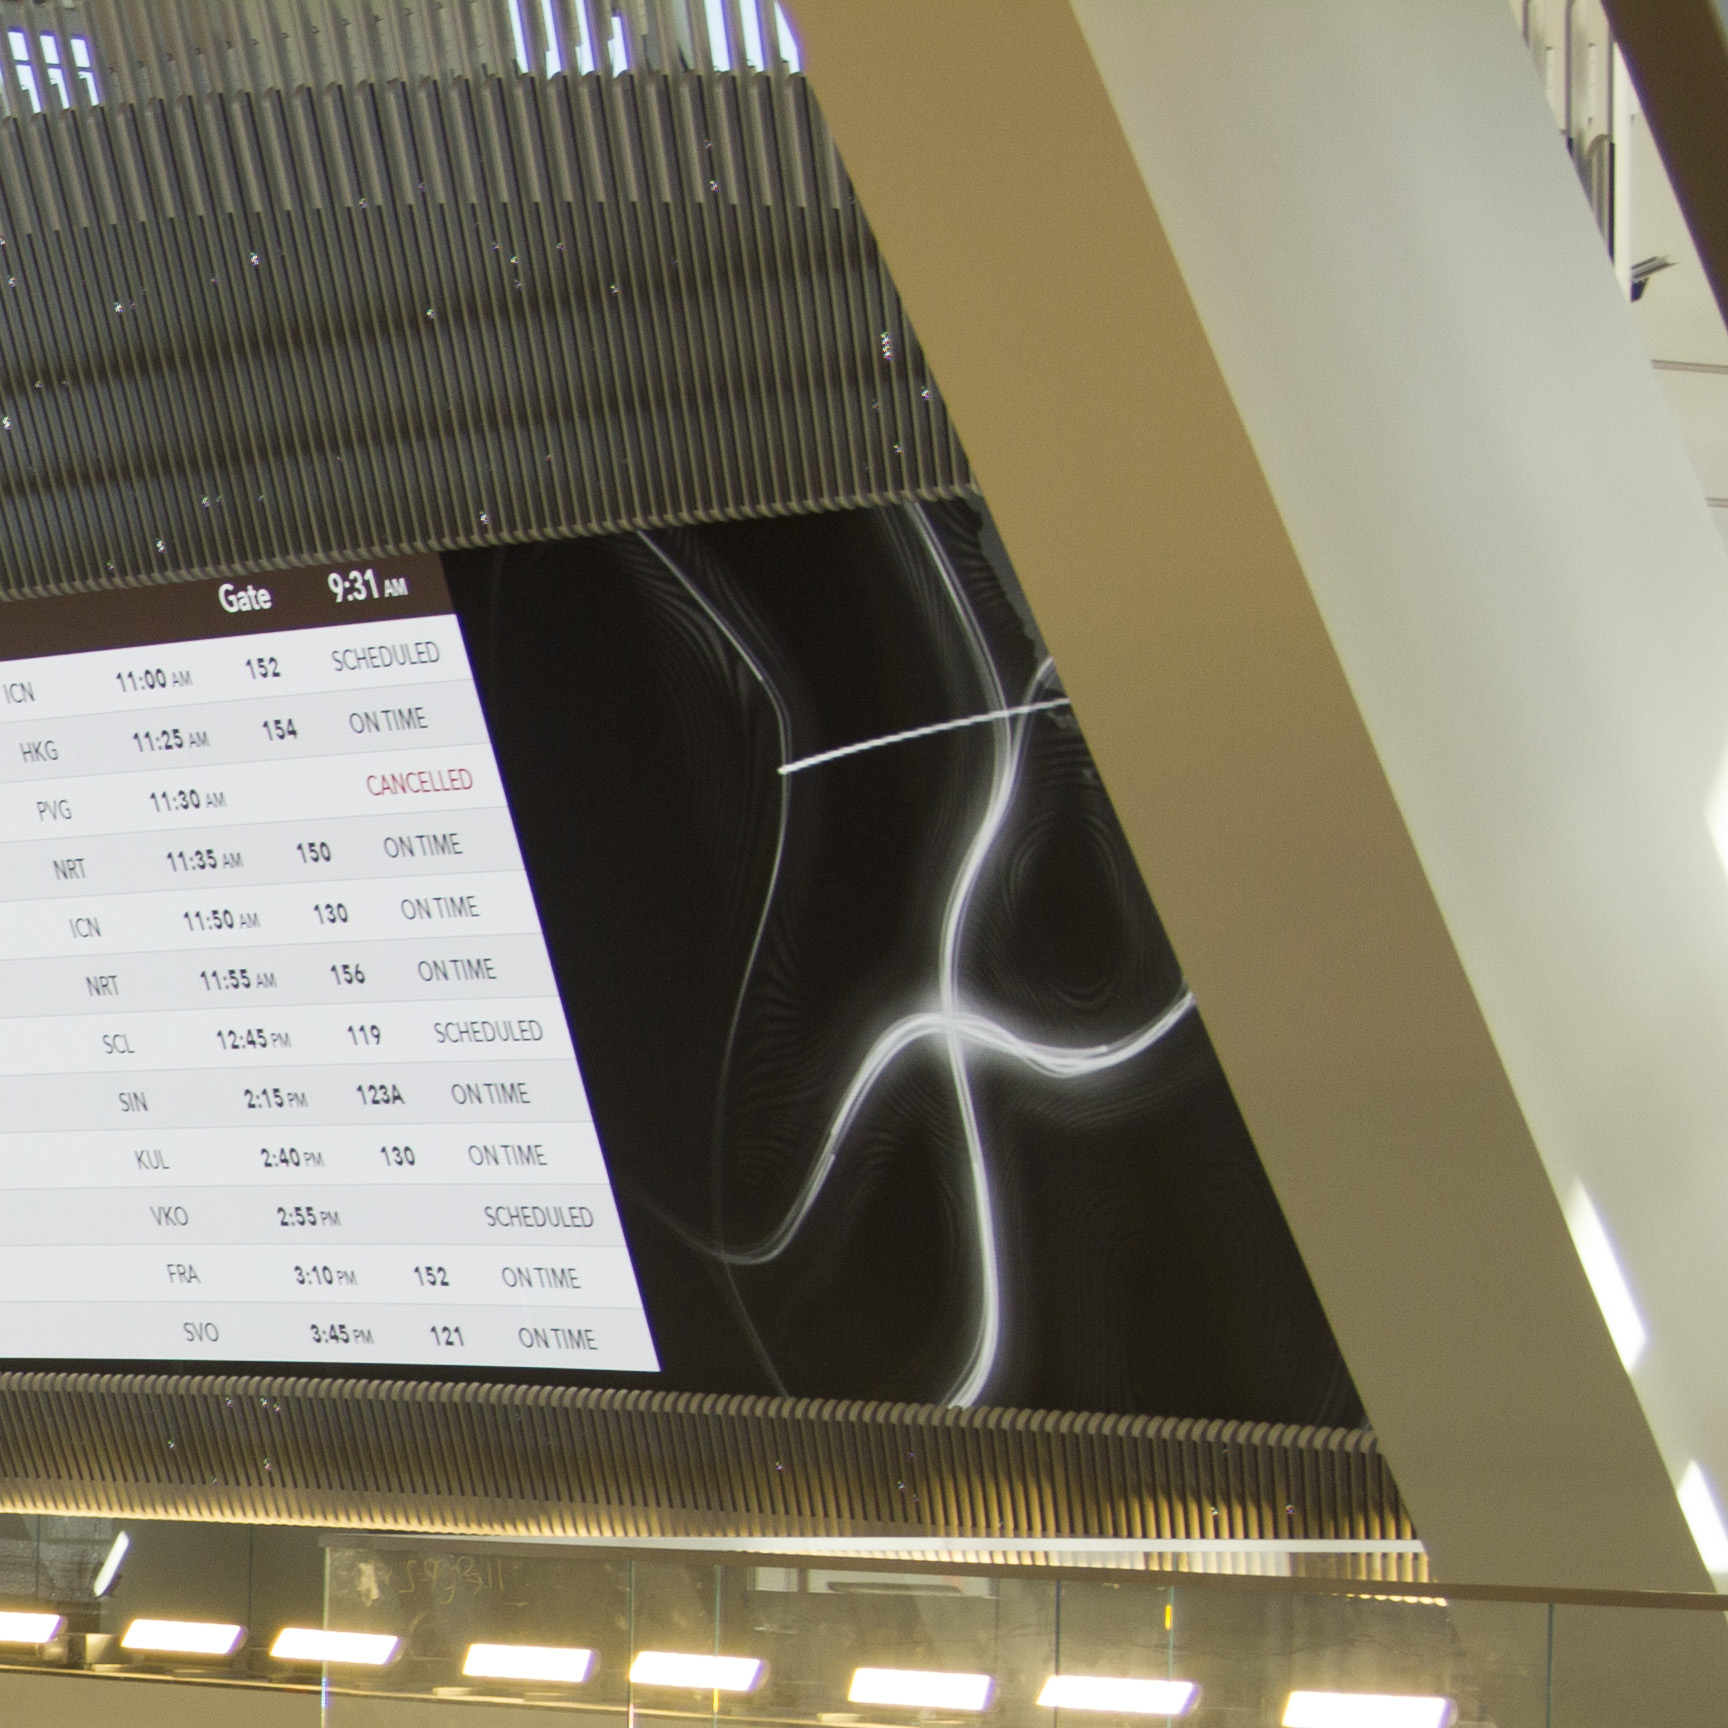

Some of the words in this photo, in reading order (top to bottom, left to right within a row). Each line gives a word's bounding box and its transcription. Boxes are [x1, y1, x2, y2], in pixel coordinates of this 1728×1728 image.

[217, 584, 273, 613] Gate
[326, 568, 380, 603] 9:31
[383, 576, 409, 597] AM
[2, 681, 35, 703] ICN
[115, 667, 167, 692] 11:00
[171, 670, 191, 686] AM
[244, 656, 282, 679] 152
[330, 640, 440, 671] SCHEDULED
[19, 739, 59, 762] HKG
[131, 727, 184, 752] 11:25
[188, 730, 209, 747] AM
[261, 717, 298, 741] 154
[348, 710, 381, 734] ON
[379, 705, 428, 730] TIME
[35, 798, 72, 820] PVG
[149, 788, 201, 812] 11:30
[205, 791, 226, 807] AM
[365, 767, 473, 796] CANCELLED
[51, 857, 85, 879] NRT
[165, 847, 218, 872] 11:35
[222, 851, 243, 868] AM
[295, 840, 332, 863] 150
[382, 835, 415, 859] ON
[414, 831, 463, 855] TIME
[69, 916, 102, 938] ICN
[182, 908, 235, 931] 11:50
[239, 912, 259, 928] AM
[312, 902, 349, 924] 130
[399, 897, 432, 920] ON
[431, 894, 480, 917] TIME
[84, 974, 118, 996] NRT
[199, 967, 252, 990] 11:55
[255, 972, 276, 988] AM
[329, 963, 366, 985] 156
[416, 959, 449, 982] ON
[448, 957, 497, 980] TIME
[101, 1033, 135, 1054] SCL
[215, 1027, 268, 1050] 12:45
[269, 1031, 290, 1046] PM
[346, 1023, 381, 1045] 119
[433, 1018, 543, 1043] SCHEDULED
[117, 1091, 148, 1112] SIN
[242, 1086, 285, 1109] 2:15
[286, 1091, 308, 1106] PM
[355, 1083, 405, 1105] 123A
[450, 1082, 483, 1105] ON
[482, 1081, 531, 1104] TIME
[134, 1149, 170, 1170] KUL
[259, 1146, 301, 1168] 2:40
[302, 1151, 323, 1165] PM
[379, 1145, 416, 1166] 130
[467, 1144, 500, 1166] ON
[499, 1143, 548, 1166] TIME
[149, 1205, 189, 1226] VKO
[275, 1205, 318, 1227] 2:55
[318, 1210, 341, 1225] PM
[483, 1205, 594, 1228] SCHEDULED
[165, 1262, 201, 1283] FRA
[293, 1264, 334, 1285] 3:10
[335, 1269, 357, 1284] PM
[412, 1265, 450, 1287] 152
[500, 1265, 533, 1288] ON
[532, 1266, 581, 1289] TIME
[182, 1321, 219, 1342] SVO
[309, 1323, 351, 1344] 3:45
[351, 1328, 373, 1343] PM
[429, 1324, 464, 1346] 121
[517, 1326, 550, 1349] ON
[549, 1327, 598, 1351] TIME
